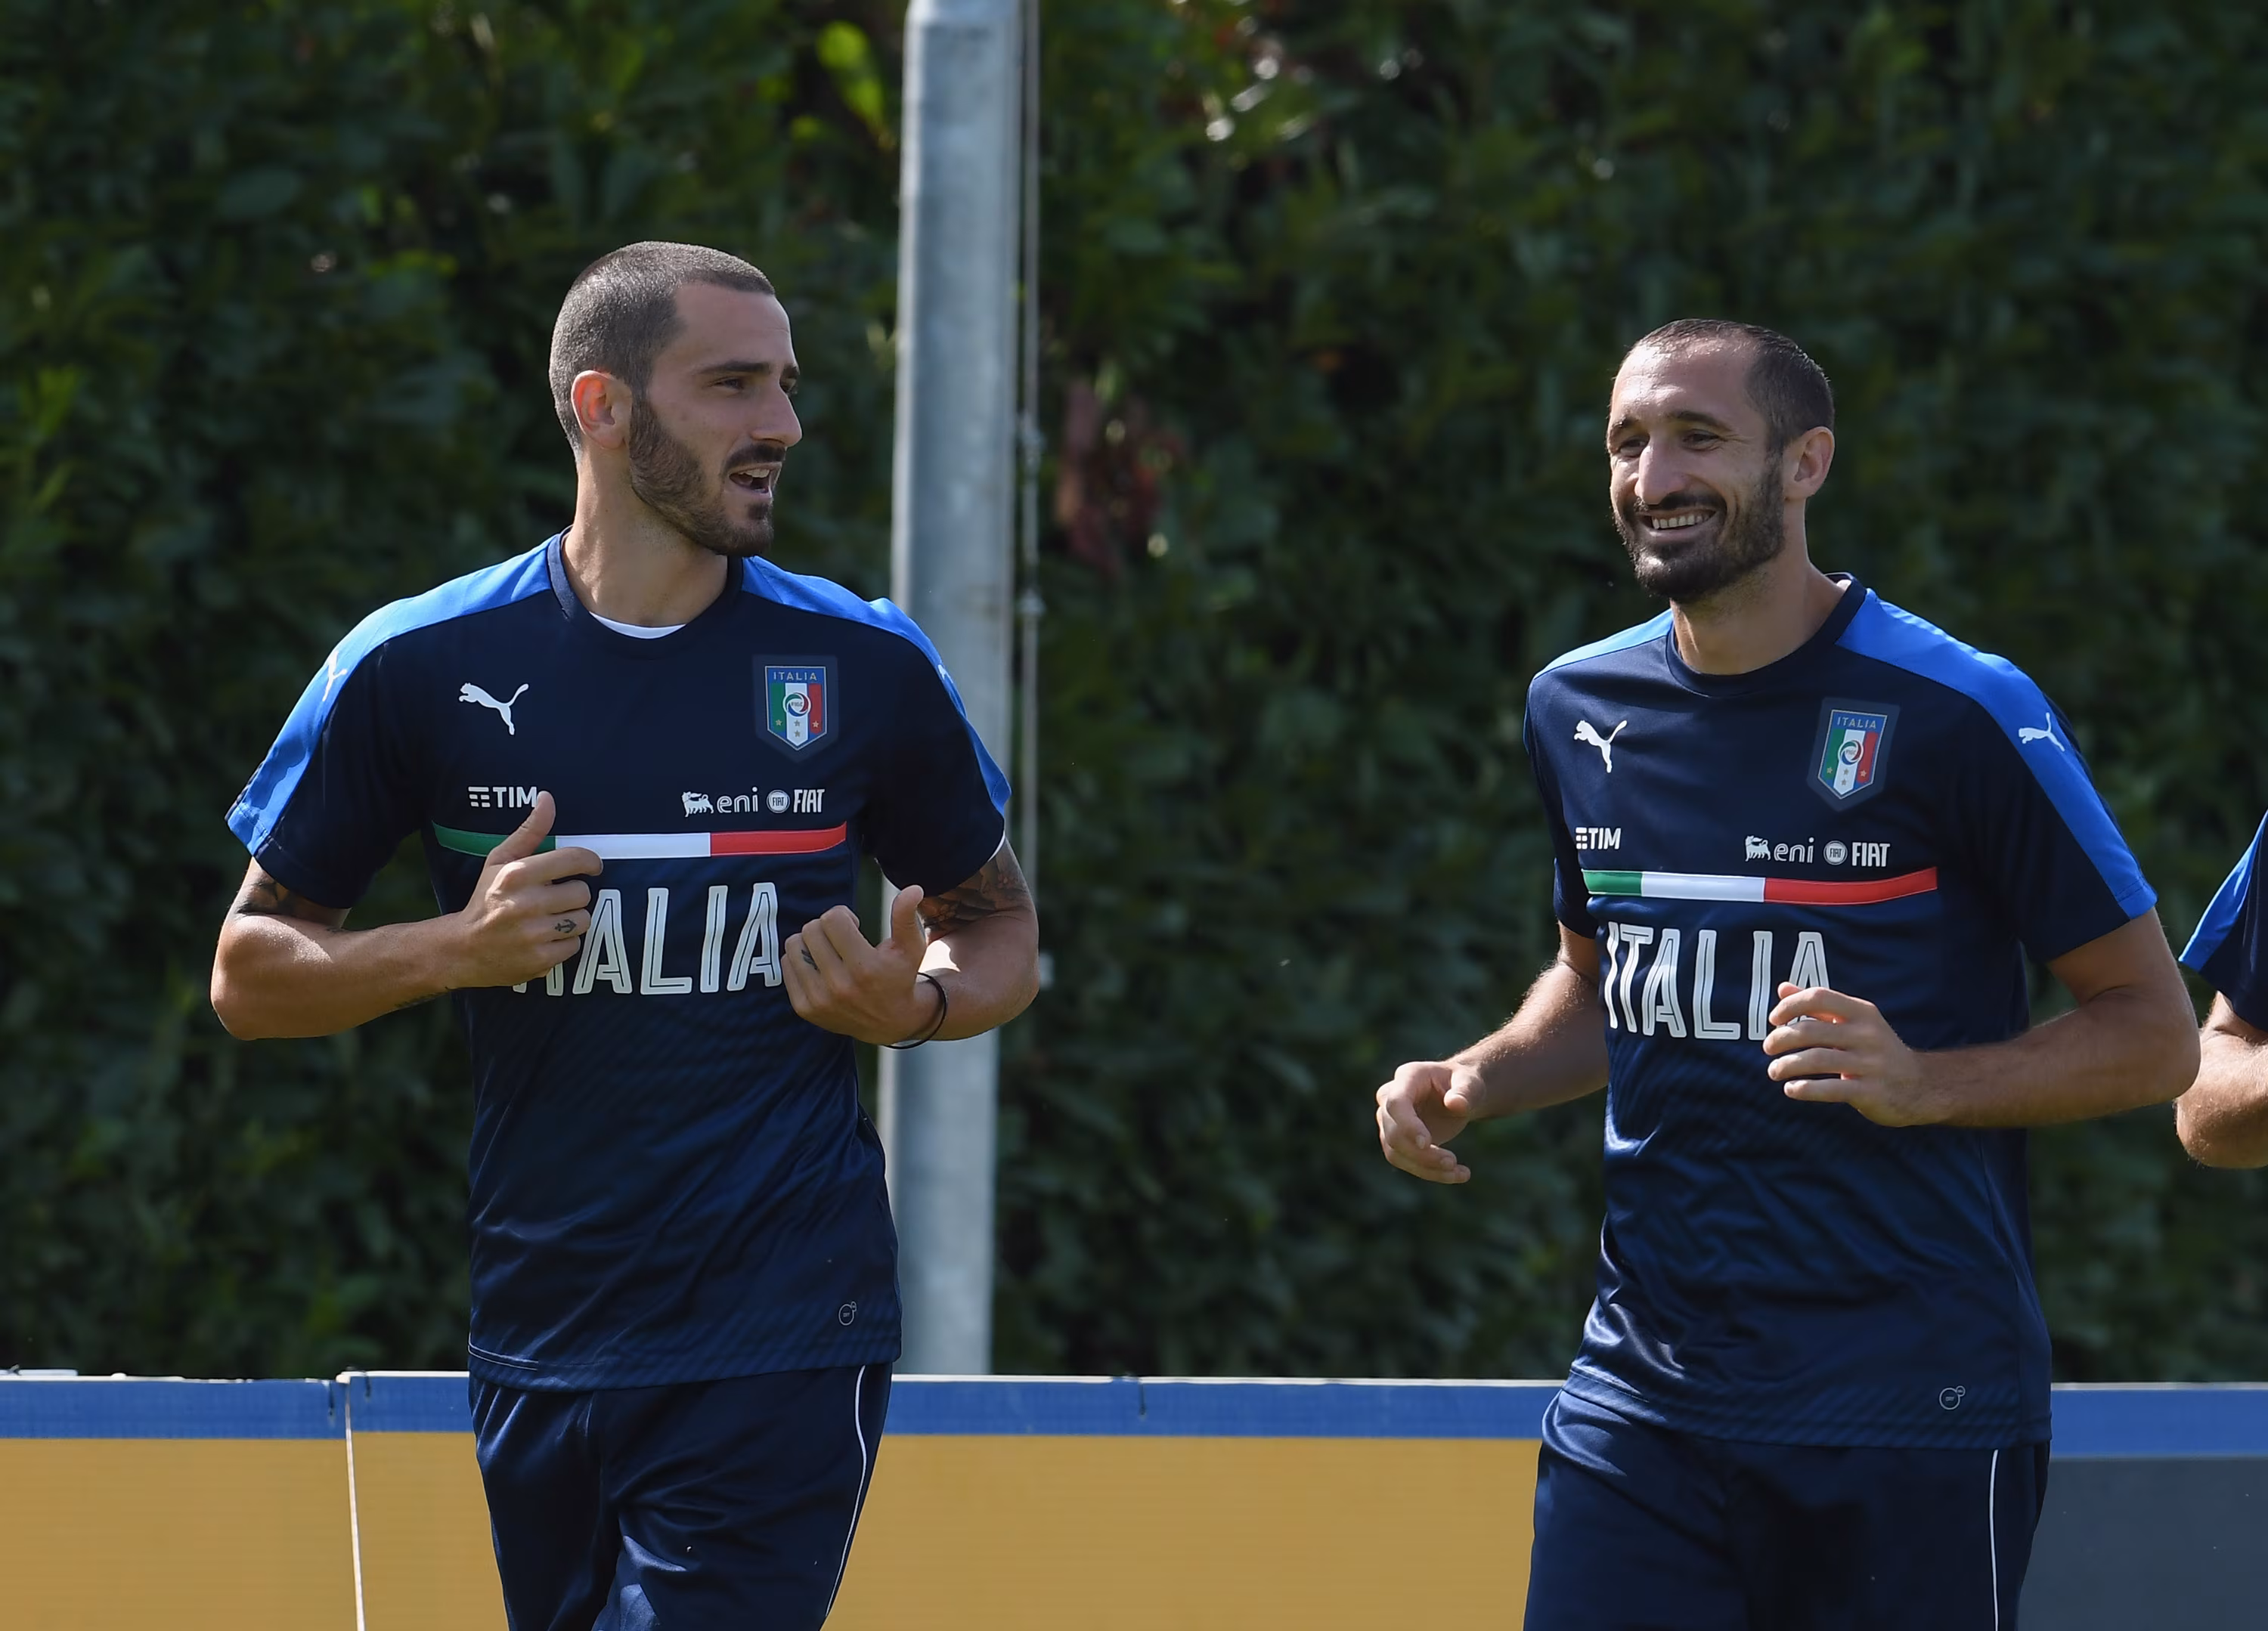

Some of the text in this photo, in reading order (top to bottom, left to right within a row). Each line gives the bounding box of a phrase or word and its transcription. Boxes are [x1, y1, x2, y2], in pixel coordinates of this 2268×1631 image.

[773, 671, 817, 681] ITALIA
[1836, 716, 1876, 729] ITALIA
[492, 786, 538, 808] TIM
[717, 787, 758, 813] eni
[772, 797, 784, 806] FIAT
[793, 788, 826, 813] FIAT
[1588, 827, 1622, 850] TIM
[1774, 837, 1814, 863] eni
[1851, 841, 1891, 867] FIAT
[513, 882, 782, 996] ALIA
